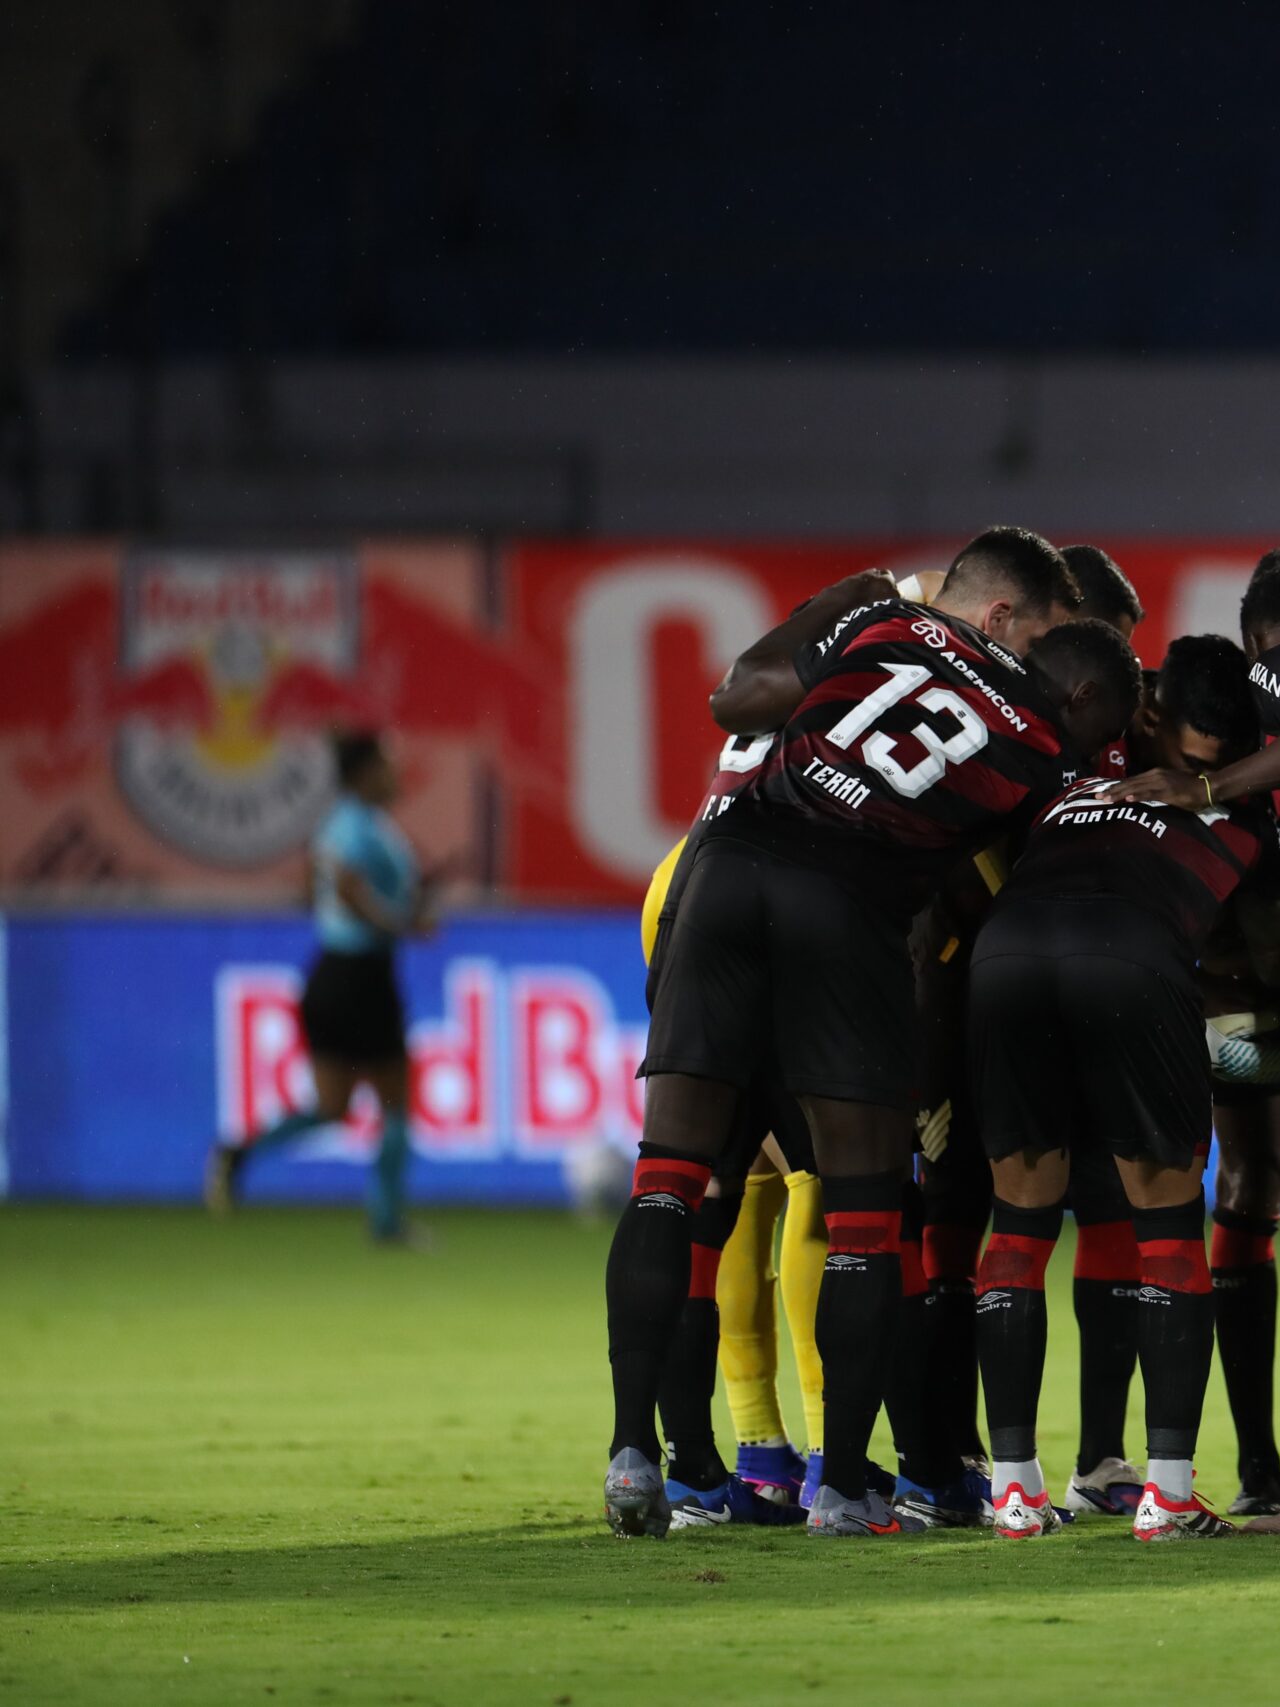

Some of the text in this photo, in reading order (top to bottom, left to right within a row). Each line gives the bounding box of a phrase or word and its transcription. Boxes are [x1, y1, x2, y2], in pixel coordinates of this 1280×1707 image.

[816, 598, 892, 656] HAVAN
[986, 642, 1028, 676] umbro
[940, 651, 1029, 733] ADEMICON
[824, 662, 989, 799] 13
[802, 756, 871, 810] TERÁN
[1058, 807, 1168, 839] PORTILLA
